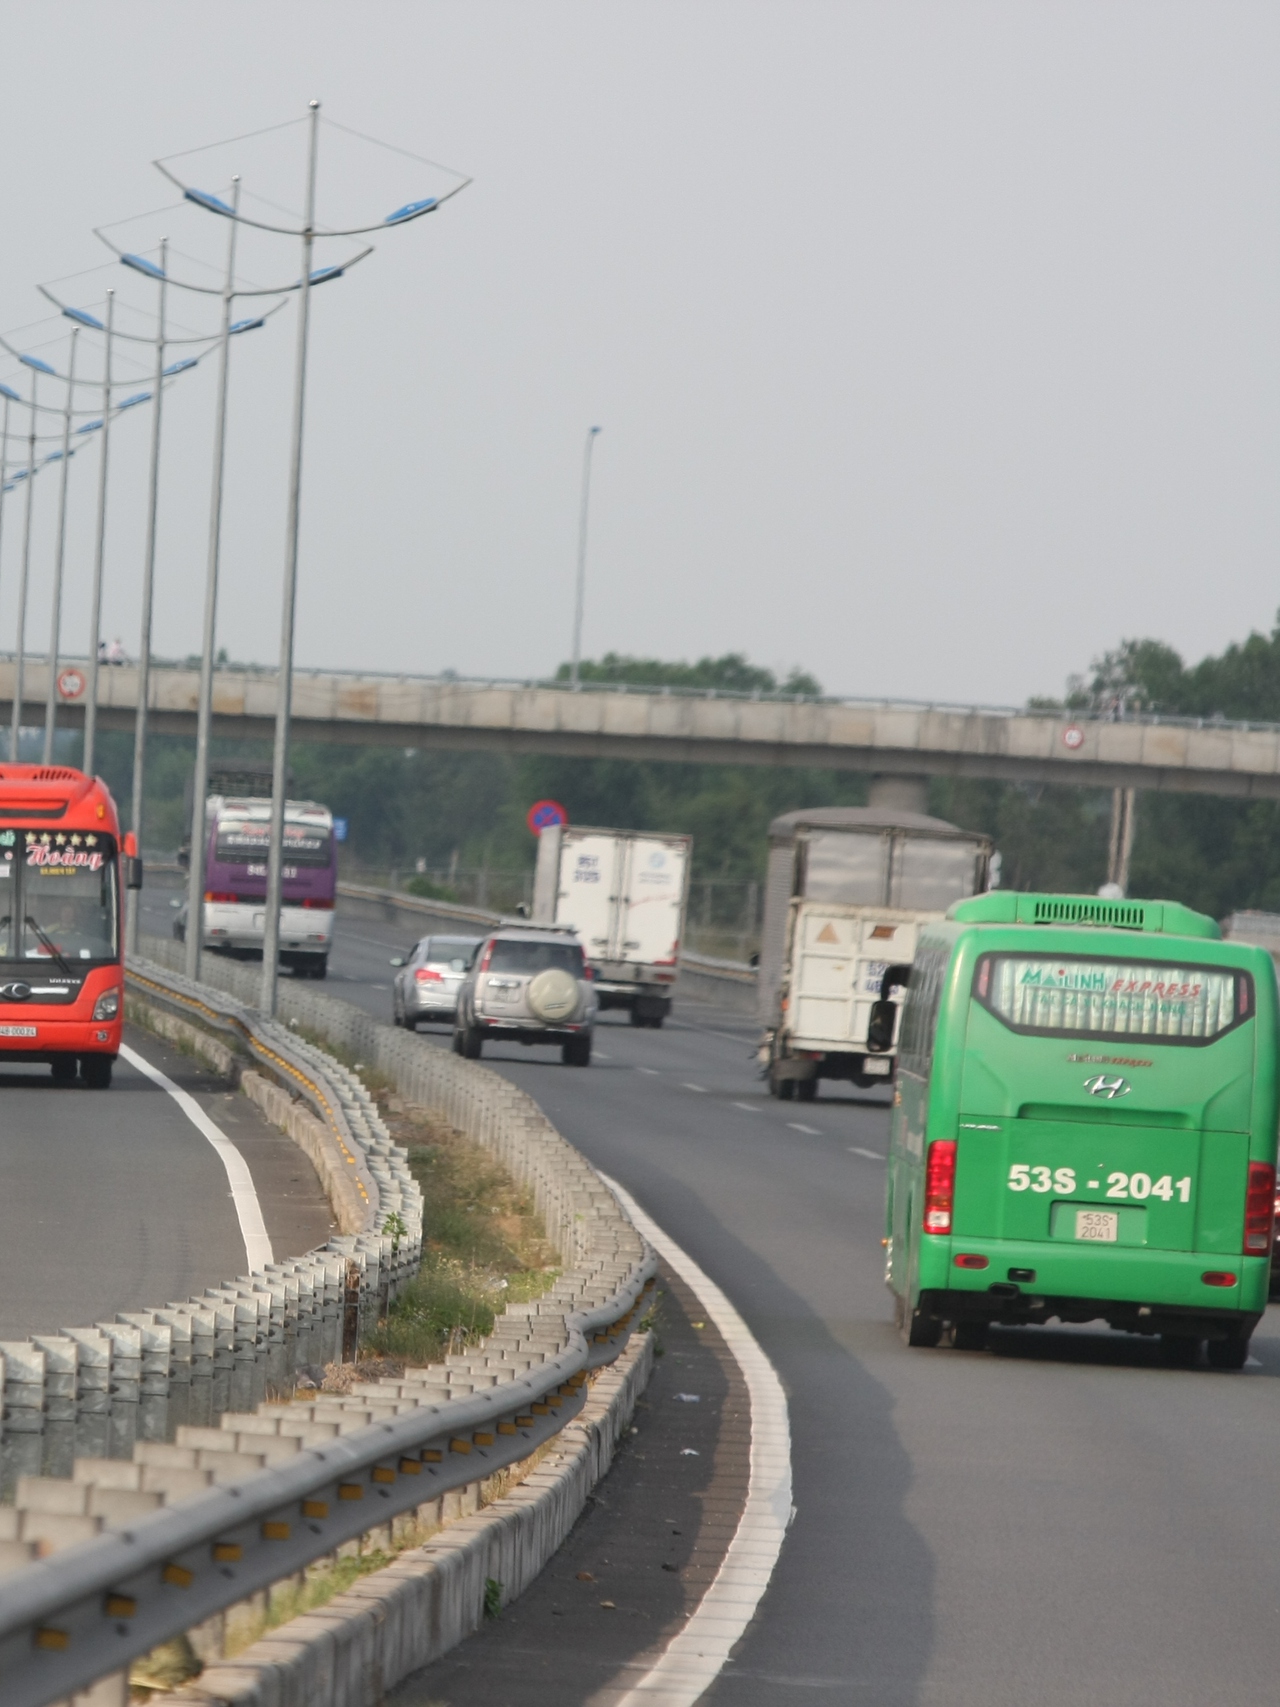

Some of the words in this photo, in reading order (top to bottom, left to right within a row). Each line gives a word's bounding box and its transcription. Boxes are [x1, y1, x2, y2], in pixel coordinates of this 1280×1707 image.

[26, 843, 104, 871] Hoàng
[1111, 979, 1202, 998] EXPRESS
[1008, 1164, 1077, 1195] 53S
[1105, 1171, 1192, 1204] 2041
[1085, 1212, 1110, 1227] 53S
[1081, 1225, 1111, 1240] 2041
